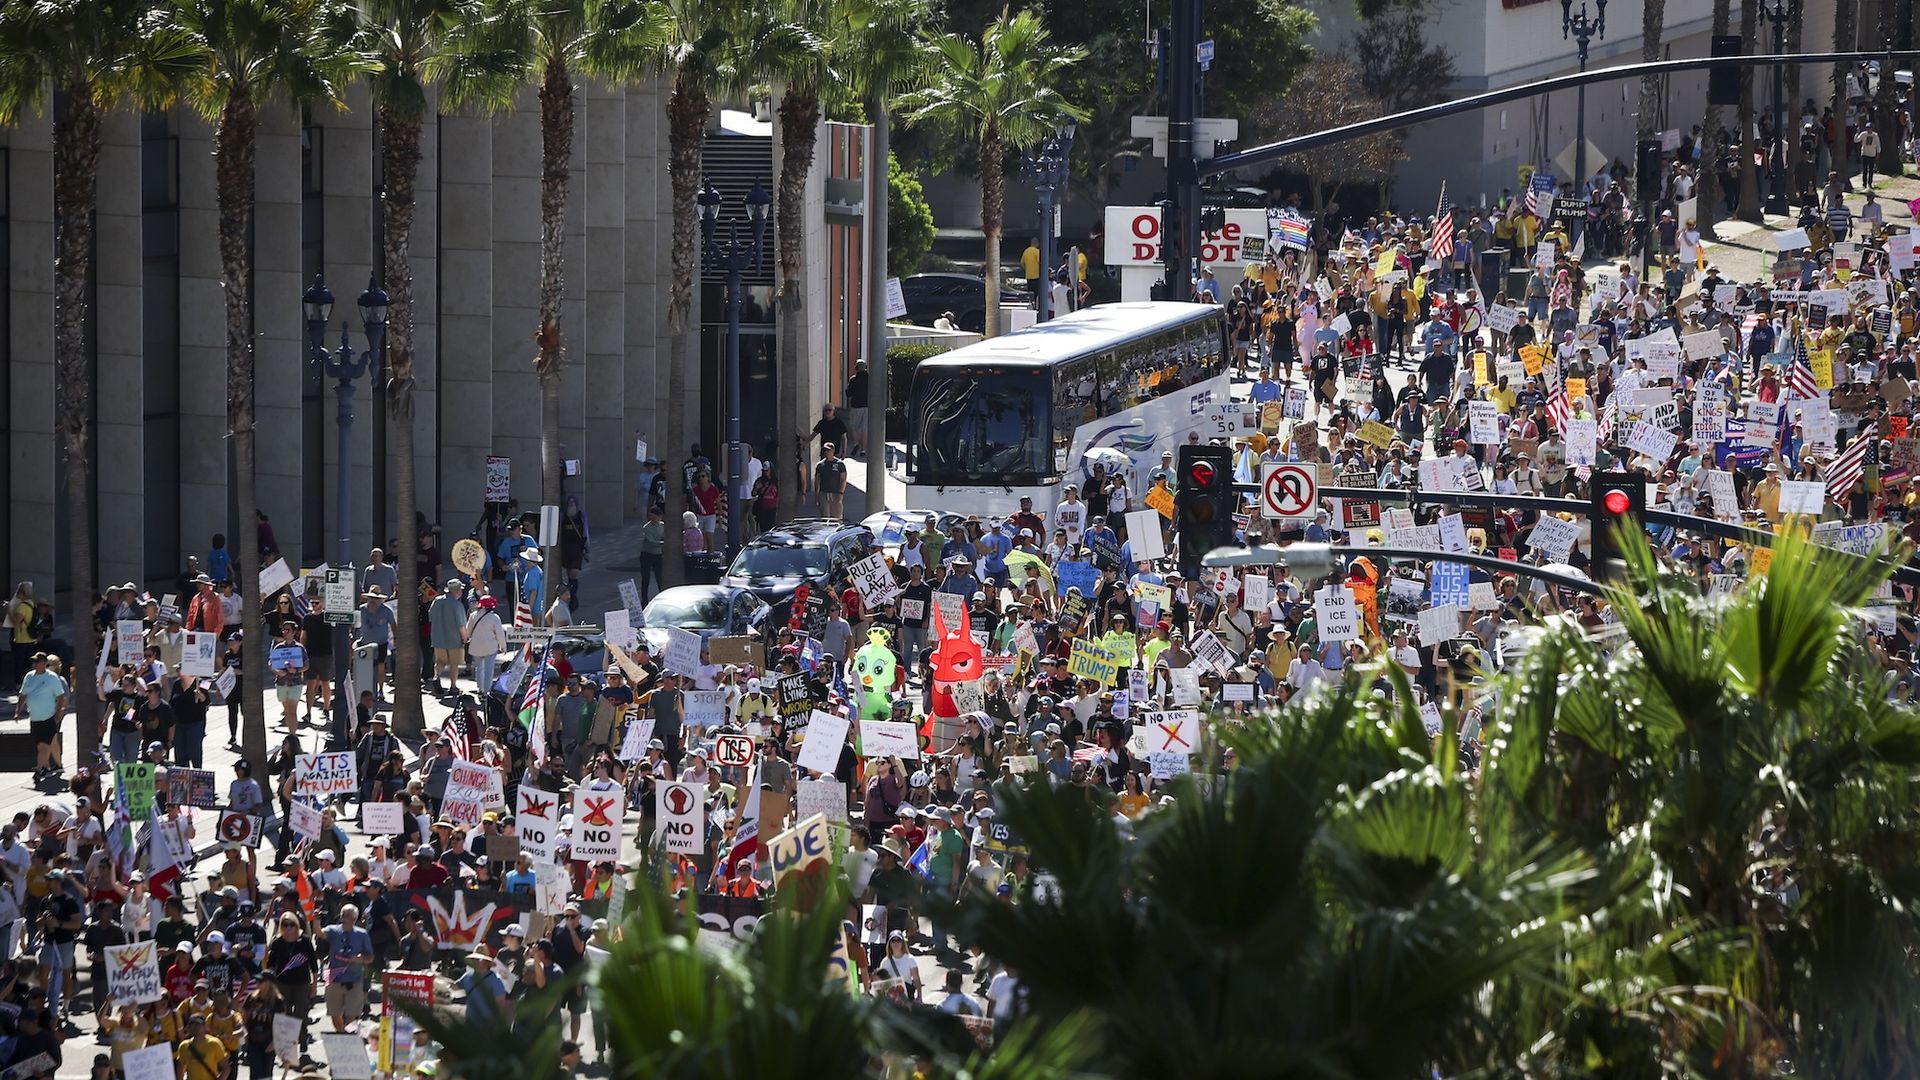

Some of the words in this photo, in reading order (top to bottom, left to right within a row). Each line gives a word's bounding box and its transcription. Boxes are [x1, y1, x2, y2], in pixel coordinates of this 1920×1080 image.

[1560, 200, 1586, 209] DUMP
[1555, 208, 1587, 218] TRUMP
[1132, 214, 1241, 241] Oce
[1132, 244, 1240, 262] DOT
[1702, 381, 1722, 390] LAND
[1220, 404, 1240, 414] YES
[1655, 402, 1675, 419] AND
[1697, 408, 1722, 417] KINGS
[1753, 409, 1774, 418] FASCISM
[1211, 414, 1224, 422] ON
[1662, 413, 1680, 428] NECK
[1702, 416, 1713, 424] NO
[1217, 421, 1235, 433] 50
[1695, 423, 1722, 432] IDIOTS
[1696, 431, 1724, 441] EITHER
[1349, 480, 1376, 489] SILENCED
[1393, 529, 1412, 541] THE
[1537, 524, 1556, 537] THAT
[1557, 530, 1574, 541] BOY
[850, 556, 881, 580] RULE
[1432, 559, 1468, 577] KEEP
[329, 573, 337, 582] P
[866, 571, 878, 583] OF
[860, 574, 889, 600] LAW
[1248, 580, 1263, 595] NO
[1440, 576, 1462, 592] US
[872, 580, 898, 606] money
[1431, 592, 1469, 607] FREE
[1324, 597, 1345, 606] END
[903, 608, 921, 617] KINGS
[1329, 611, 1346, 620] ICE
[1327, 625, 1351, 635] NOW
[1073, 639, 1117, 662] DUMP
[1072, 653, 1115, 682] TRUMP
[782, 674, 805, 692] MAKE
[693, 694, 722, 705] STOP
[784, 687, 808, 703] LYING
[781, 698, 812, 717] WRONG
[685, 711, 725, 722] INJUSTICE
[784, 711, 809, 730] AGAIN
[1149, 714, 1164, 724] NO
[1168, 712, 1188, 721] KINGS
[722, 739, 747, 762] ICE
[302, 753, 349, 772] VETS
[125, 766, 148, 779] NO
[302, 769, 351, 781] AGAINST
[127, 791, 144, 807] IS
[443, 800, 479, 823] MIGRA
[667, 821, 695, 836] NO
[990, 822, 1009, 840] YES
[523, 827, 546, 844] NO
[583, 830, 612, 843] NO
[669, 839, 693, 848] WAY!
[774, 823, 826, 872] WE
[520, 844, 546, 858] KINGS
[575, 846, 618, 856] CLOWNS
[112, 967, 131, 982] NO
[390, 977, 412, 988] Don't
[413, 978, 426, 988] let
